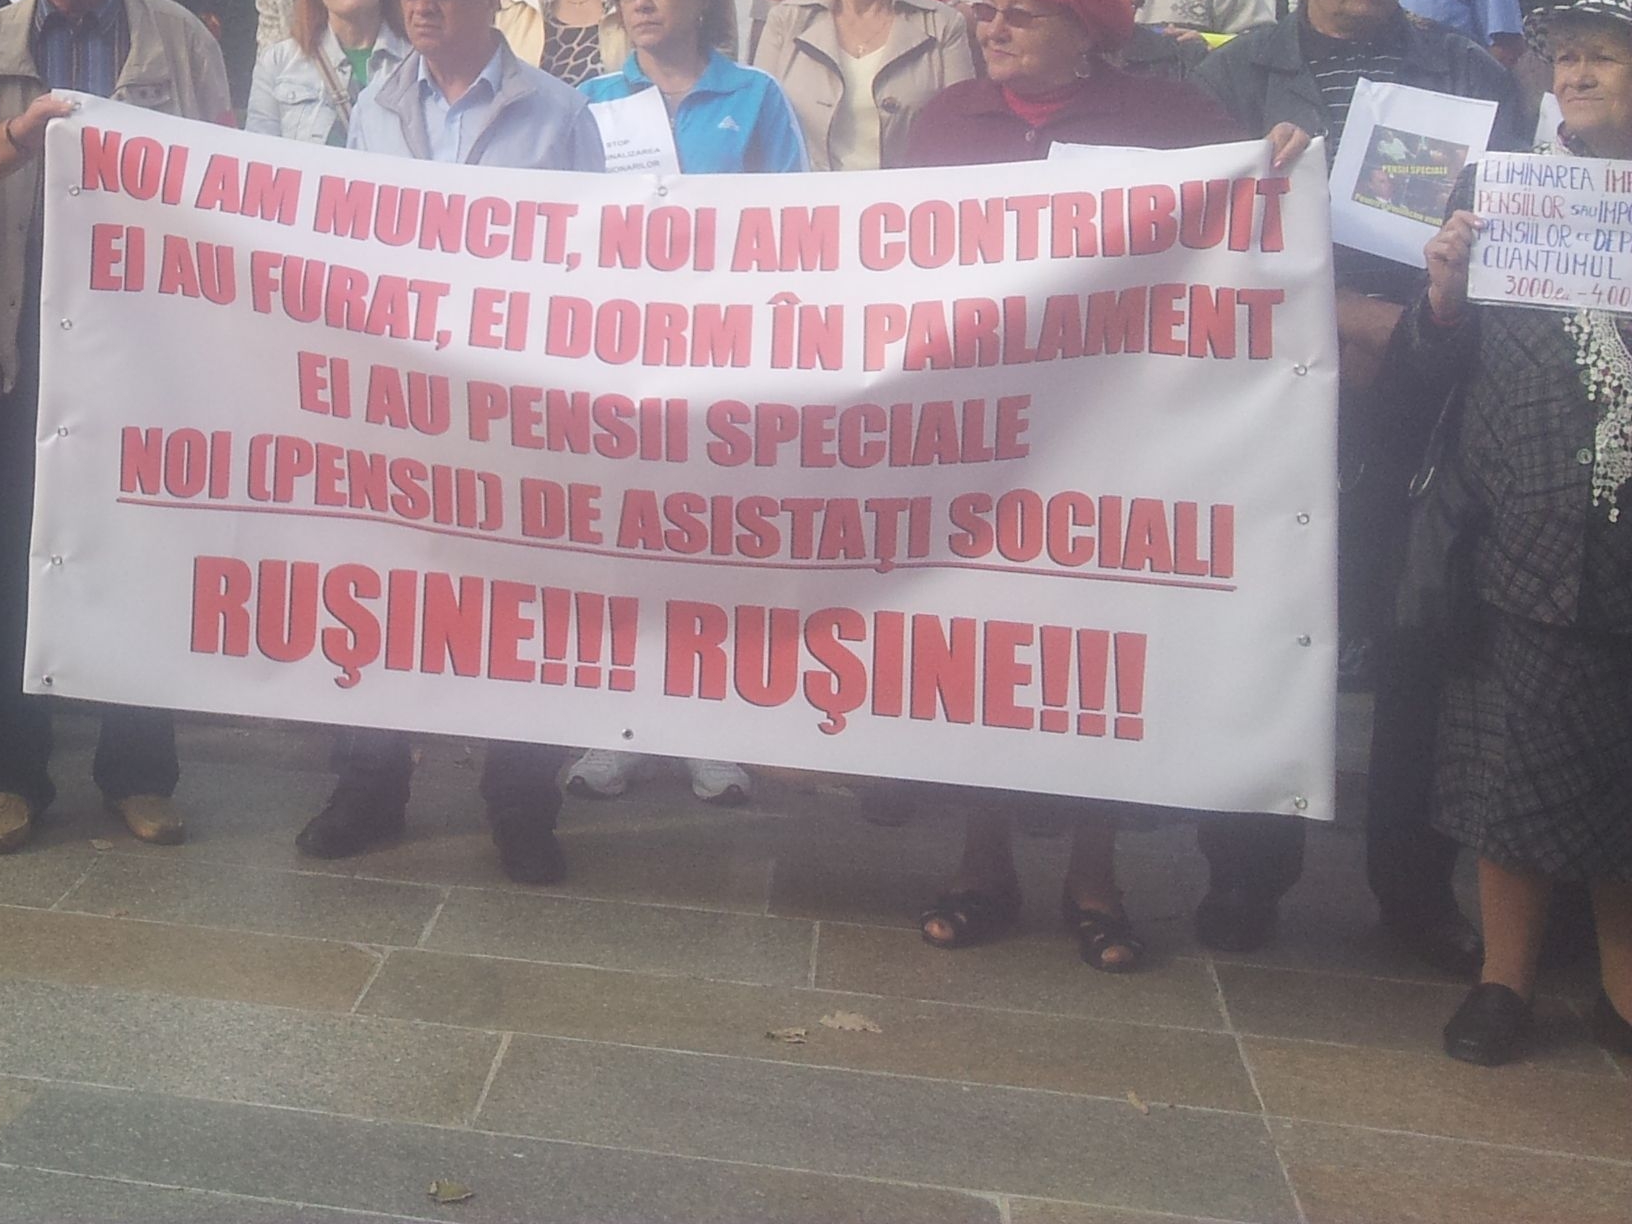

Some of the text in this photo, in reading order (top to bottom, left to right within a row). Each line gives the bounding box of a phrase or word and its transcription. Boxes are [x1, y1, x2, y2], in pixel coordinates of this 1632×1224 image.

[81, 126, 188, 205] NOI
[195, 153, 302, 226] AM
[314, 175, 578, 272] MUNCIT,
[598, 204, 716, 272] NOI
[730, 205, 840, 273] AM
[859, 177, 1291, 270] CONTRIBUIT
[1478, 188, 1565, 219] PENSIILOR
[1483, 155, 1595, 191] ELIMINAREA
[89, 223, 1285, 373] EI AU FURAT, EI DORM ÎN PARLAMENT
[1483, 244, 1622, 281] CUANTUMUL
[297, 350, 1033, 469] EI AU PENSII SPECIALE
[120, 426, 231, 499] NOI
[248, 433, 503, 531] (PENSII)
[520, 477, 604, 545] DE
[948, 487, 1235, 579] SOCIALI
